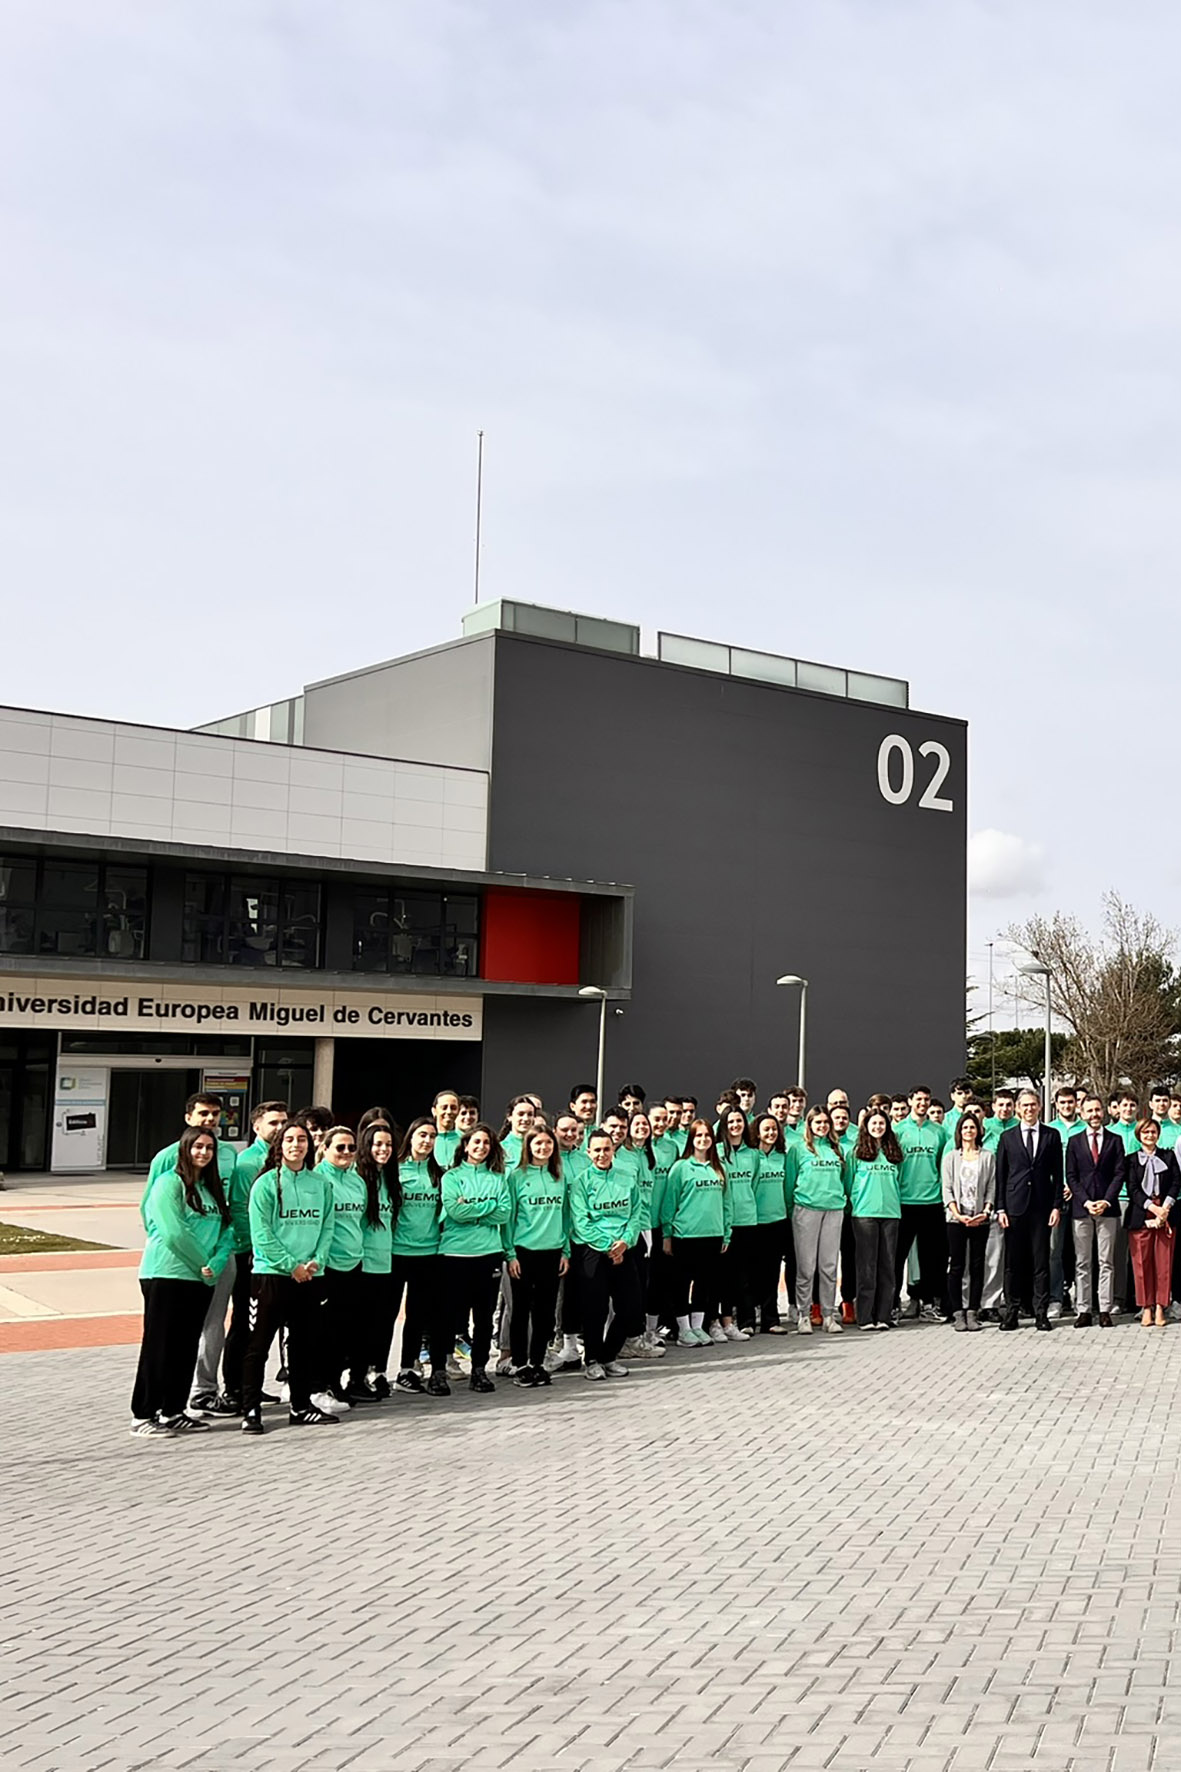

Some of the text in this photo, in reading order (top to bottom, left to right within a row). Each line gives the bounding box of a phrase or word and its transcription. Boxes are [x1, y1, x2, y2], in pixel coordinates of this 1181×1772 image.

[877, 734, 953, 812] 02
[138, 998, 239, 1024] Europea
[249, 1002, 325, 1026] Miguel
[333, 1005, 360, 1024] de
[368, 1006, 473, 1027] Cervantes
[279, 1209, 320, 1219] UEMC
[593, 1198, 629, 1210] UEMC
